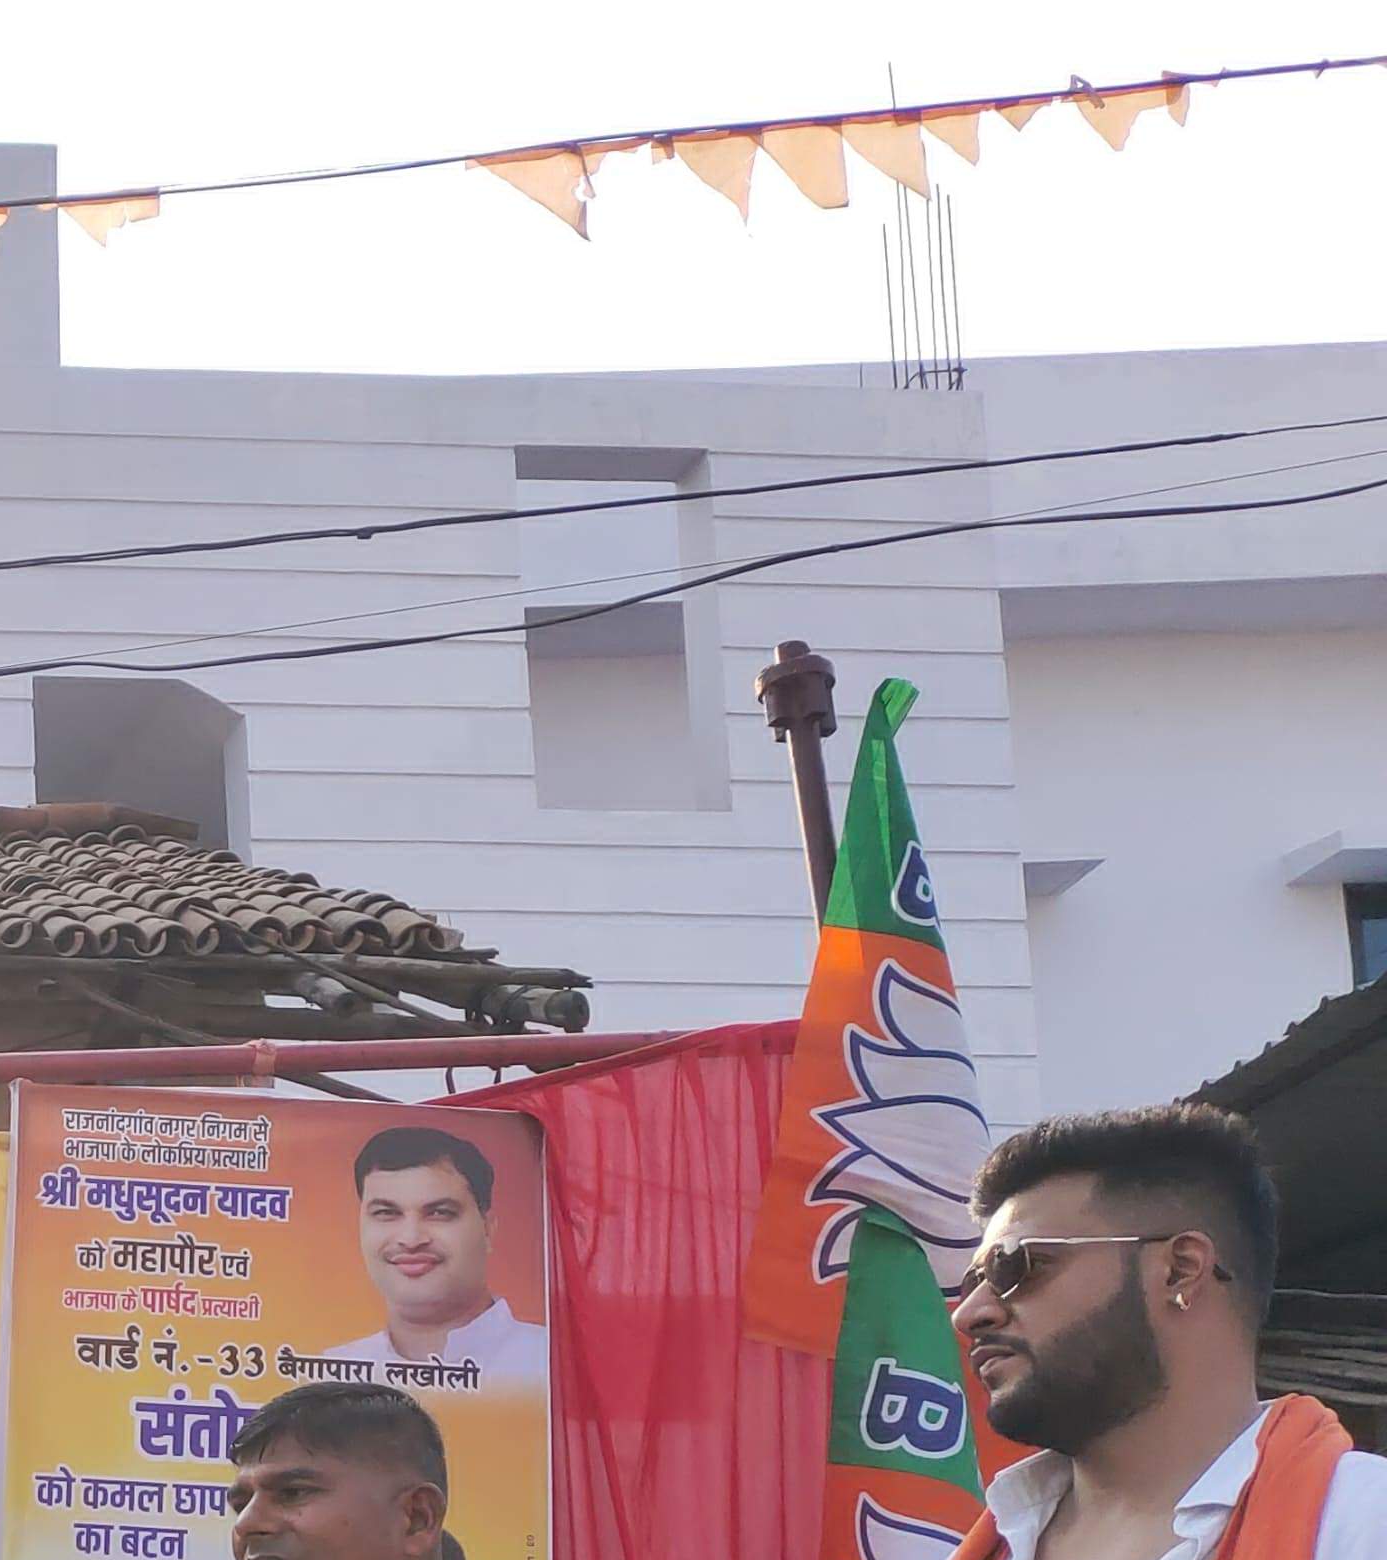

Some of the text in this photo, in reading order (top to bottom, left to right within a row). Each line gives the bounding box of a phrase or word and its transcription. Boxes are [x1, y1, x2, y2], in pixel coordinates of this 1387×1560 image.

[158, 1115, 196, 1138] नगर
[199, 1112, 249, 1140] निगम
[251, 1116, 269, 1142] से
[65, 1139, 267, 1170] भाजपा के लोकप्रिय प्रत्याशी
[42, 1168, 289, 1223] श्री मधुसूदन यादव
[78, 1236, 249, 1278] को महापौर एवं
[65, 1283, 259, 1320] भाजपा के पार्षद प्रत्याशी
[77, 1325, 139, 1370] वार्ड
[278, 1347, 374, 1384] बैगापारा
[386, 1357, 481, 1390] लखोली
[36, 1466, 226, 1517] को कमल छाप
[74, 1522, 187, 1560] का बटन
